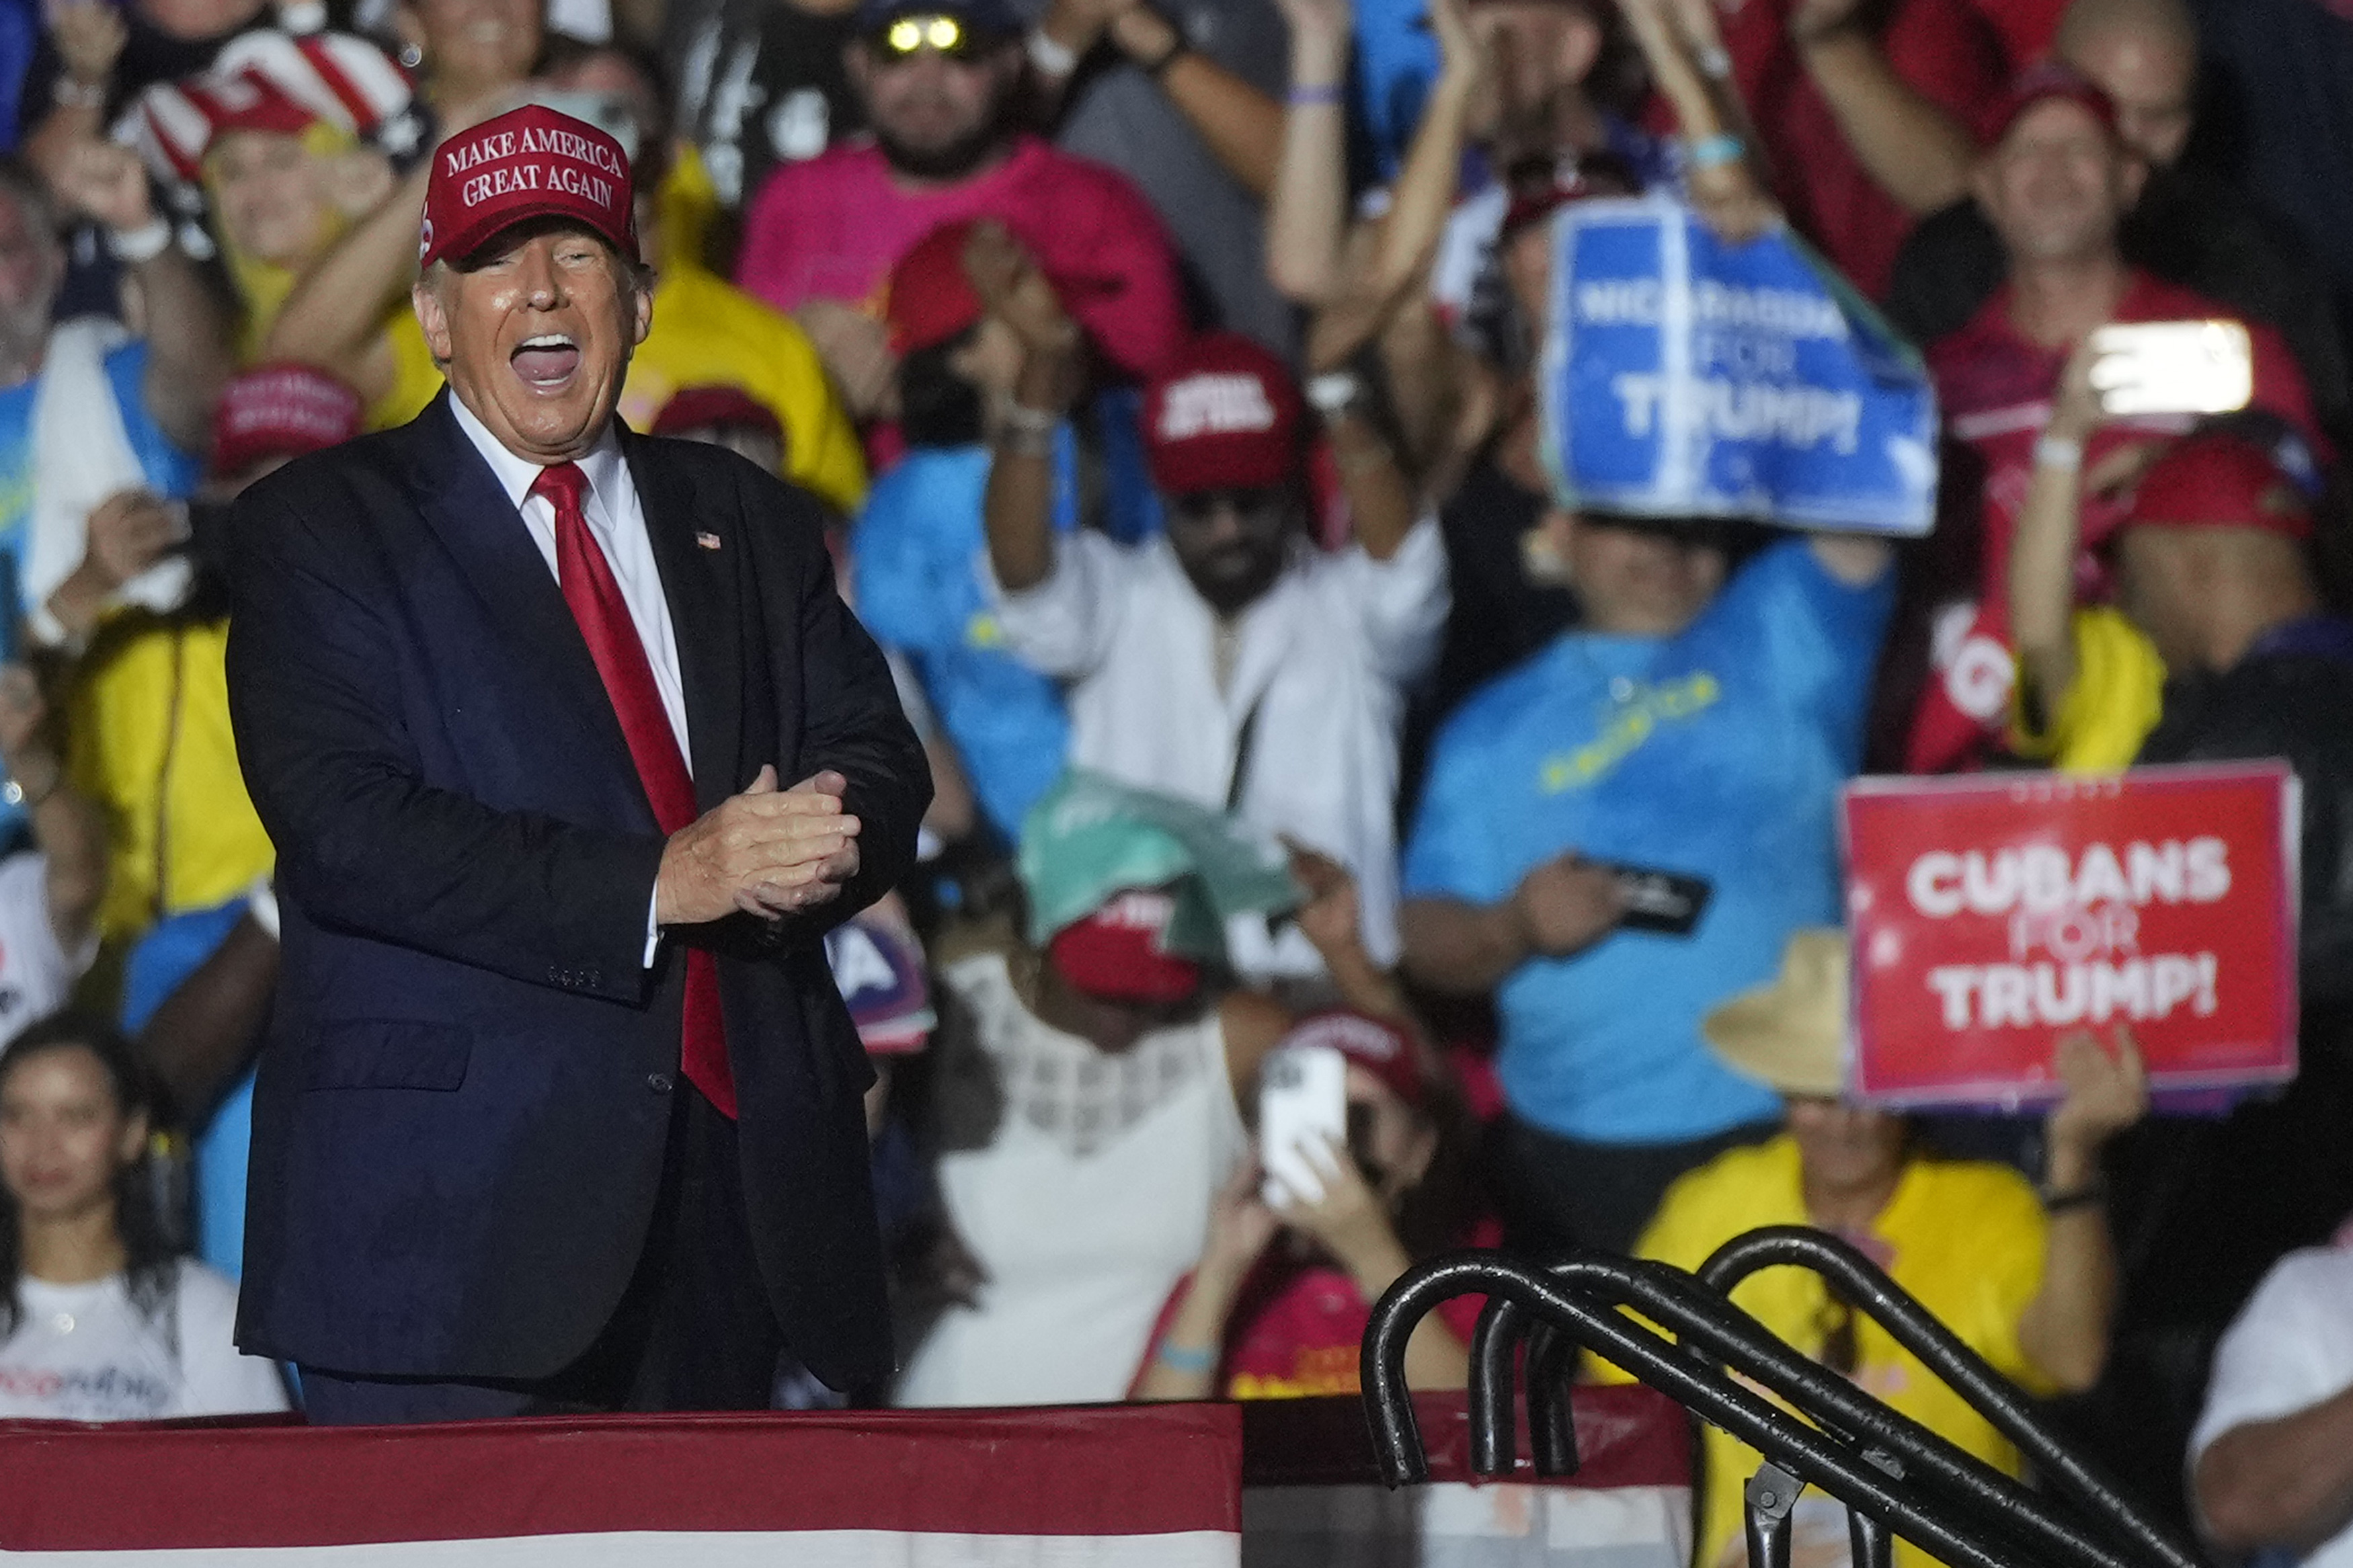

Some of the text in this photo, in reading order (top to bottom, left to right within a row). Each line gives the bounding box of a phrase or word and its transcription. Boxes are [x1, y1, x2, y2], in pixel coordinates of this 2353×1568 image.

[446, 126, 625, 179] MAKE AMERICA
[463, 165, 613, 210] GREAT AGAIN
[1907, 835, 2231, 918] CUBANS
[2009, 899, 2141, 965] FOR
[1927, 950, 2218, 1031] TRUMP!
